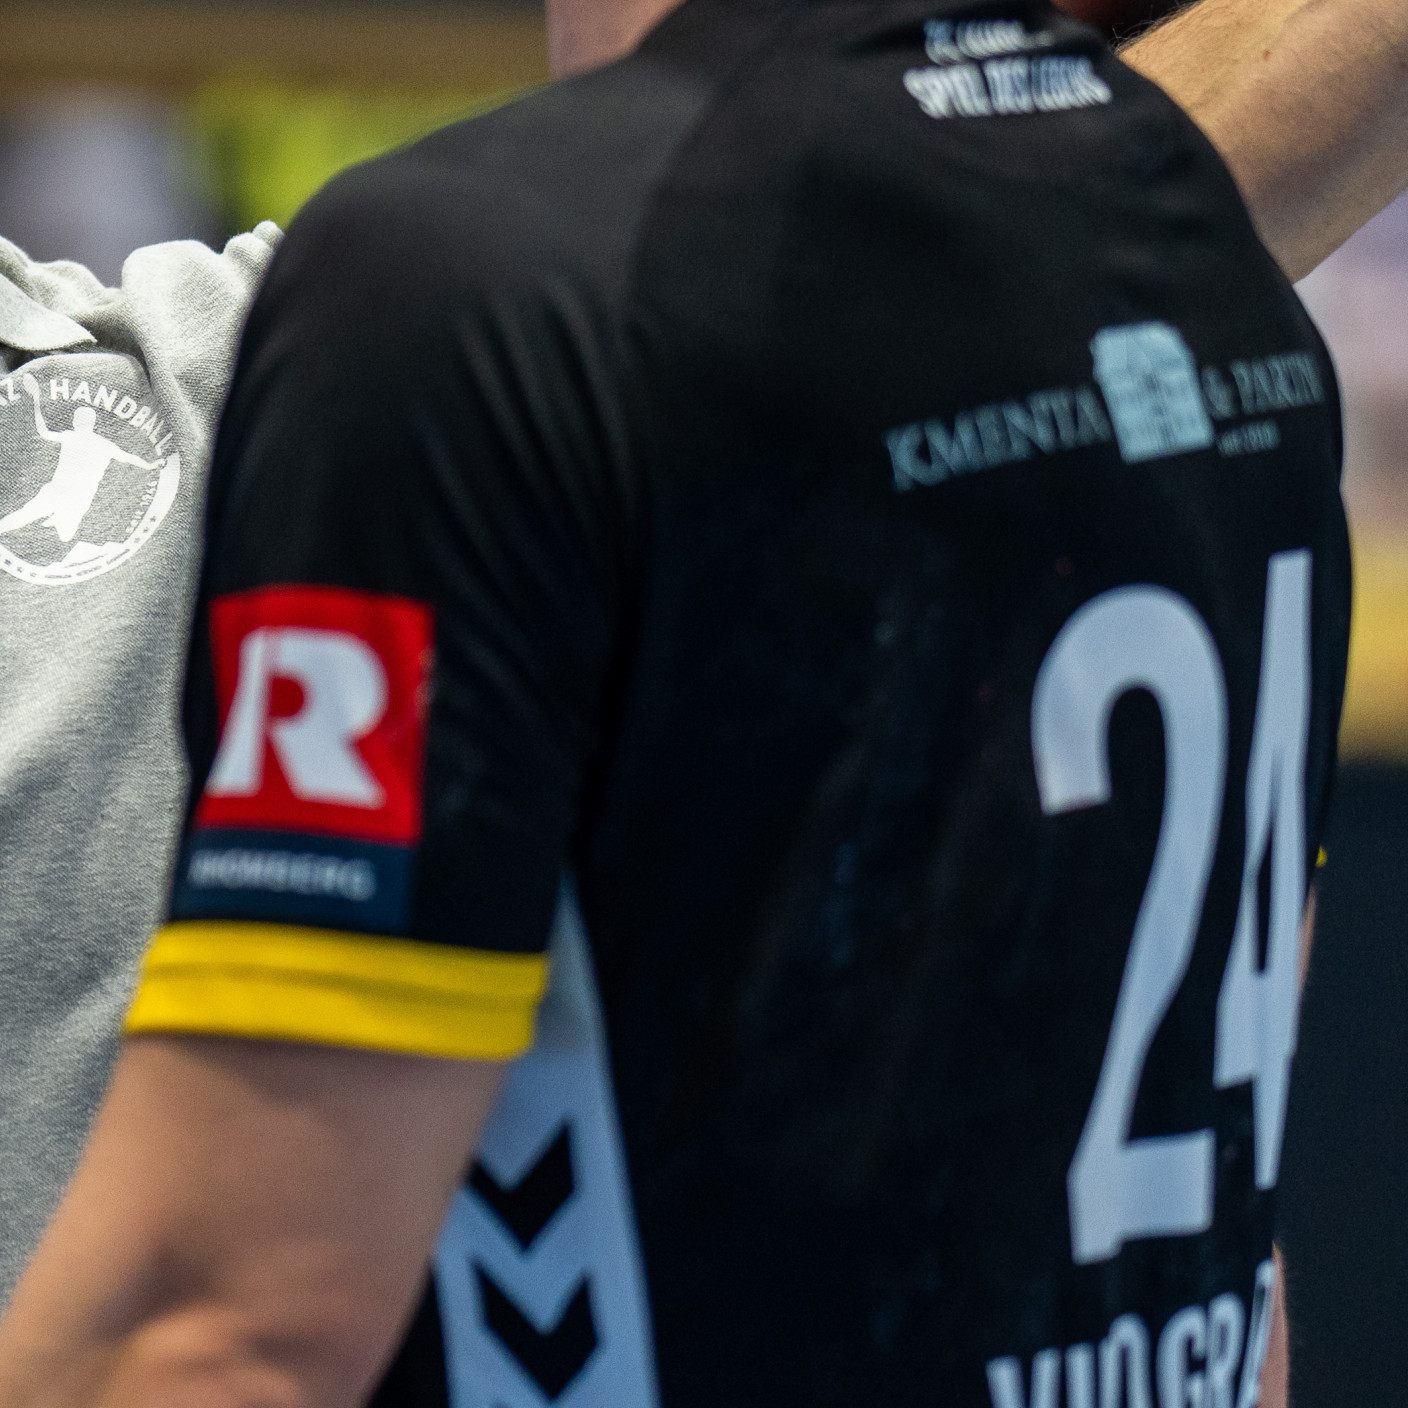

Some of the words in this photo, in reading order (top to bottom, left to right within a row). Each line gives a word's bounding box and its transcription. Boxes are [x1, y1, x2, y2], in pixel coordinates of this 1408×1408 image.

[49, 378, 174, 457] HANDBALL
[883, 386, 1111, 490] KMENTA
[202, 624, 390, 811] R
[1030, 549, 1314, 1266] 24
